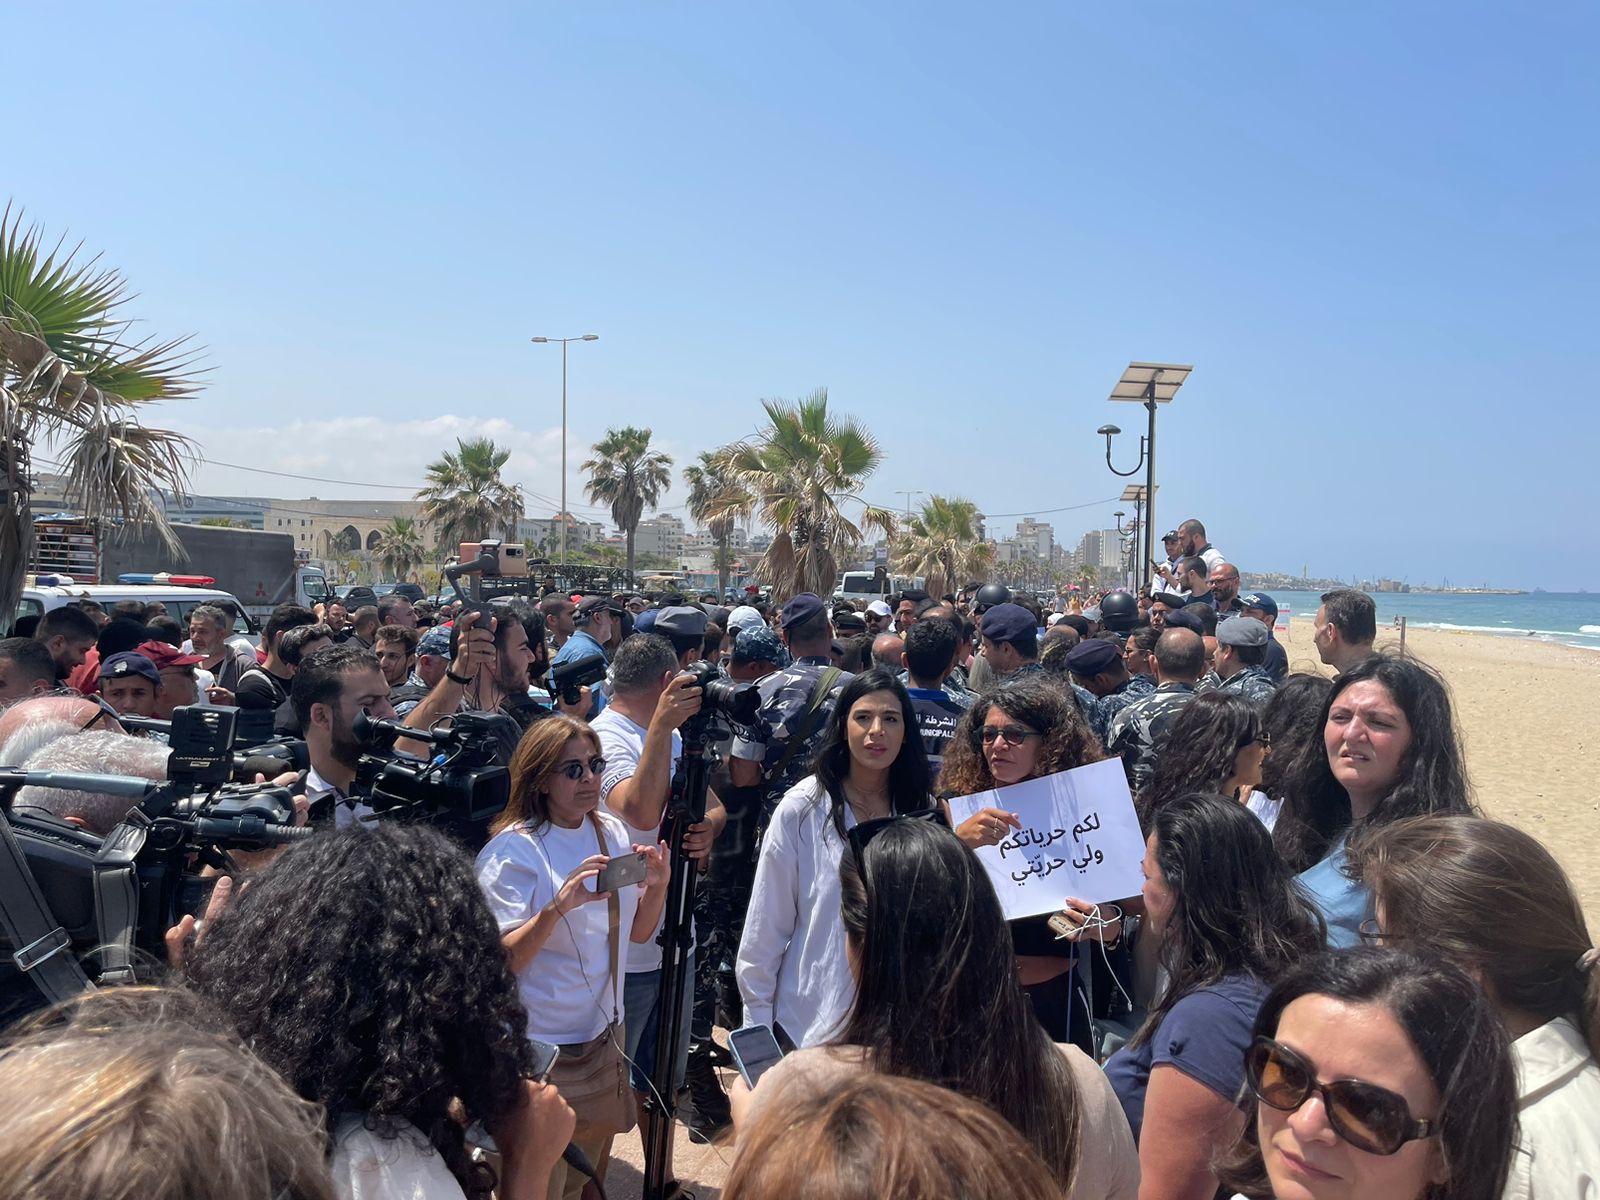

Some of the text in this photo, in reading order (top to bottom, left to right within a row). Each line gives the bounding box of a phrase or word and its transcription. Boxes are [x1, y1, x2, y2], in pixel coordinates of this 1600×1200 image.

[925, 714, 957, 727] الشرطة
[1000, 812, 1101, 860] لكم حرياتكم
[1072, 844, 1104, 874] ولي
